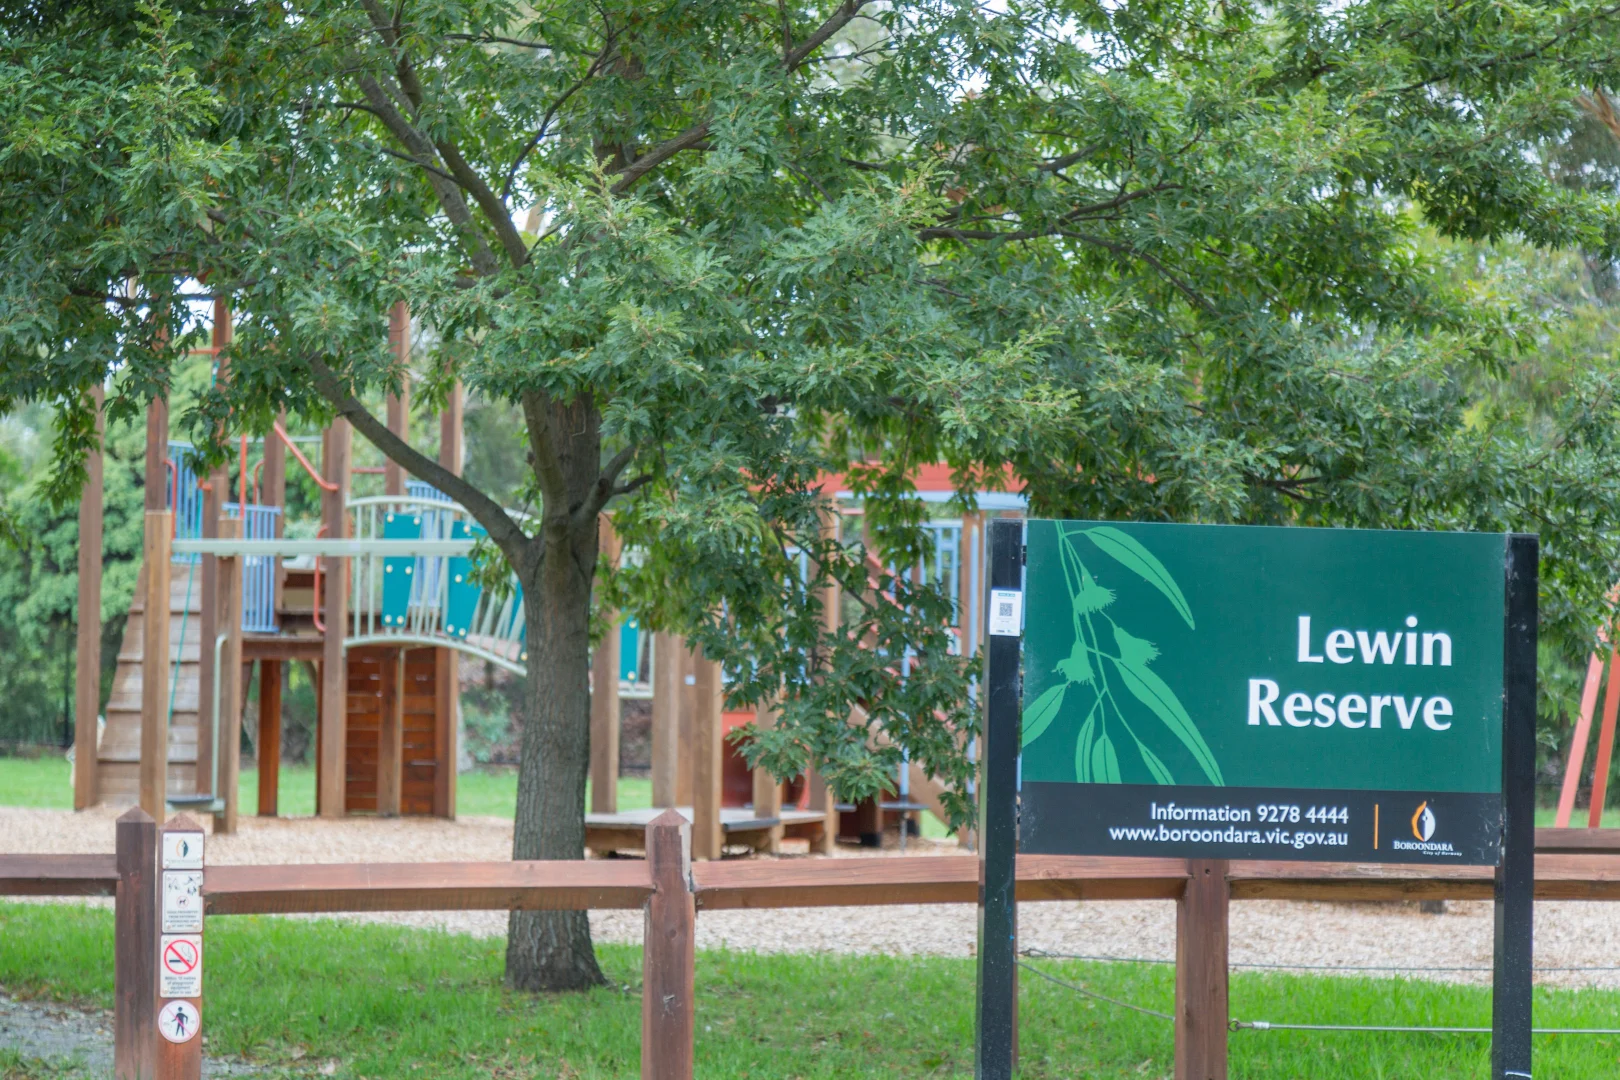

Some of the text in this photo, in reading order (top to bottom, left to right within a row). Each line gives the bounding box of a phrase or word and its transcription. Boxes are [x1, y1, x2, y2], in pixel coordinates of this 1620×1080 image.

[1297, 615, 1453, 666] Lewin
[1247, 678, 1454, 731] Reserve
[1151, 803, 1349, 824] Information 9278 4444
[1109, 825, 1348, 849] www.boroondara.vic.gov.au
[1393, 840, 1454, 852] BOROONDARA
